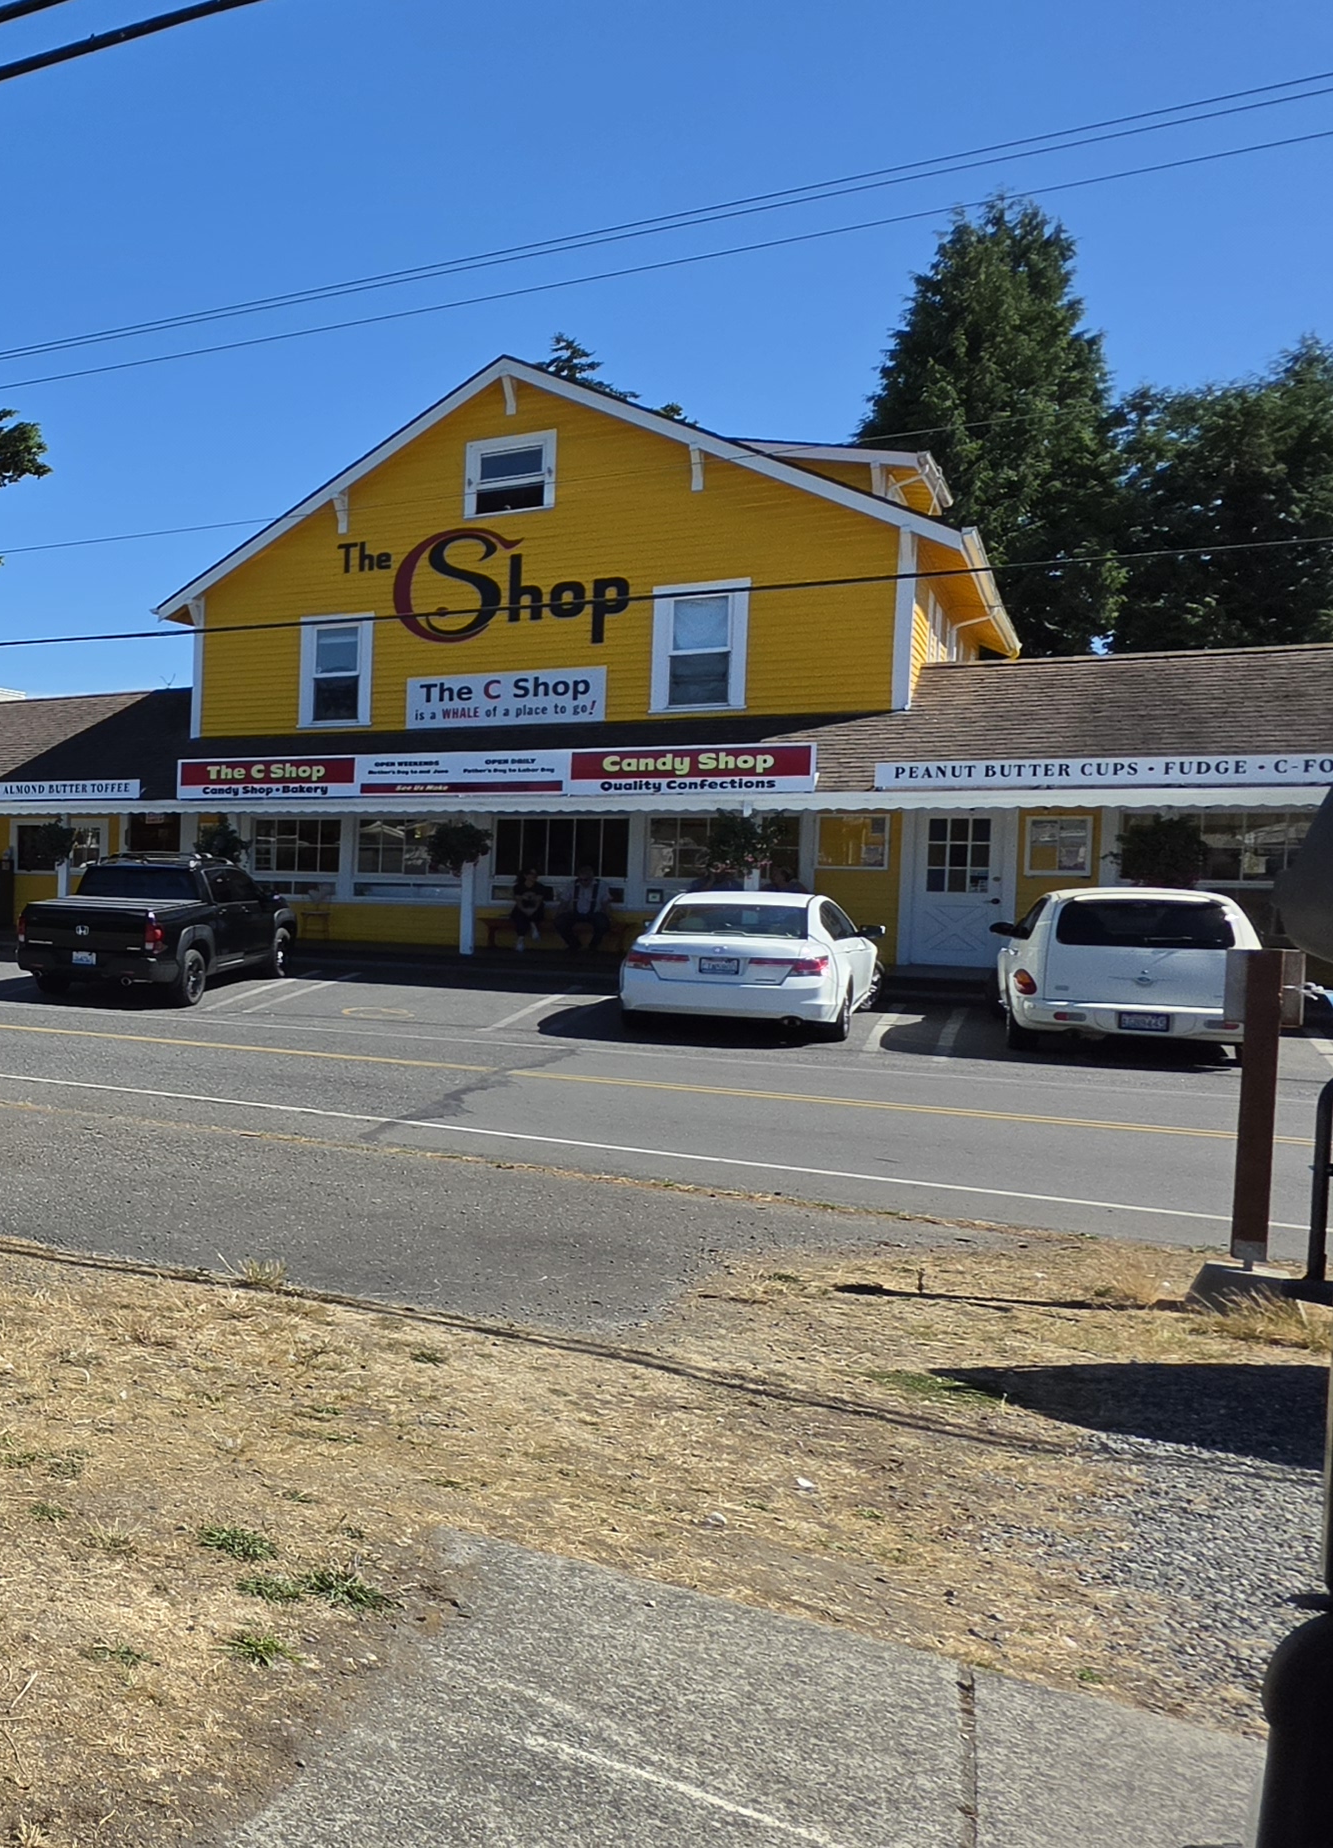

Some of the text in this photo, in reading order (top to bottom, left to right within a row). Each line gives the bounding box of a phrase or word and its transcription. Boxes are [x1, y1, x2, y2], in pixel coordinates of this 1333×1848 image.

[337, 541, 392, 574] The
[420, 676, 591, 703] The C Shop
[415, 700, 597, 721] is a WHALE of a place to go!
[207, 762, 326, 781] The C Shop
[493, 767, 507, 775] Day
[540, 766, 555, 774] Day
[602, 752, 775, 775] Candy Shop
[894, 765, 976, 779] PEANUT
[984, 763, 1071, 778] BUTTER
[1080, 762, 1138, 776] CUPS
[1163, 760, 1248, 775] FUDGE
[2, 784, 45, 795] ALMOND
[48, 783, 87, 794] BUTTER
[91, 782, 131, 793] TOFFEE
[202, 785, 328, 796] Candy Shop Bakery
[600, 778, 776, 793] Quality Confections
